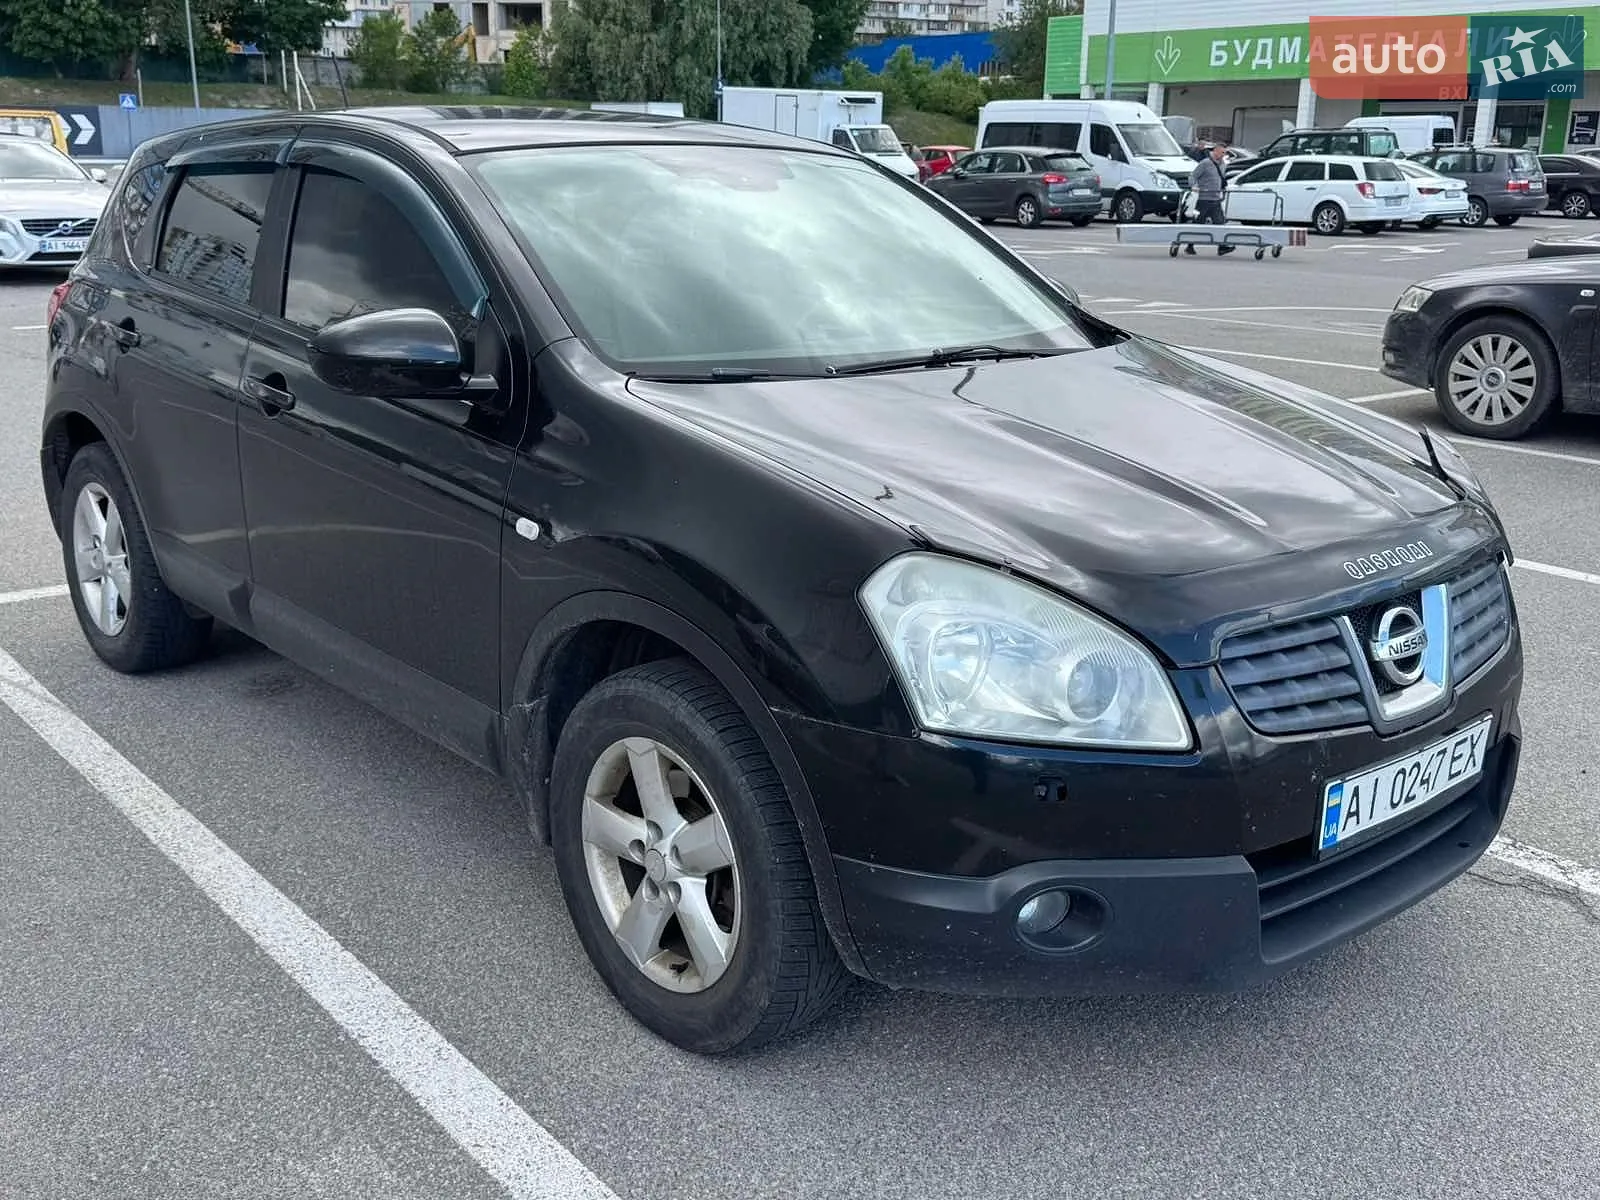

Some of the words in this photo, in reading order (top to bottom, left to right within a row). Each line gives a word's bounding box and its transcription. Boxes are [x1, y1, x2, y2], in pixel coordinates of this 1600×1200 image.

[1344, 541, 1433, 579] QASHQAI
[1388, 634, 1426, 656] NISSA
[1342, 778, 1379, 832] AI
[1390, 748, 1448, 809] 0247
[1447, 729, 1484, 781] EX
[1324, 823, 1337, 838] UA
